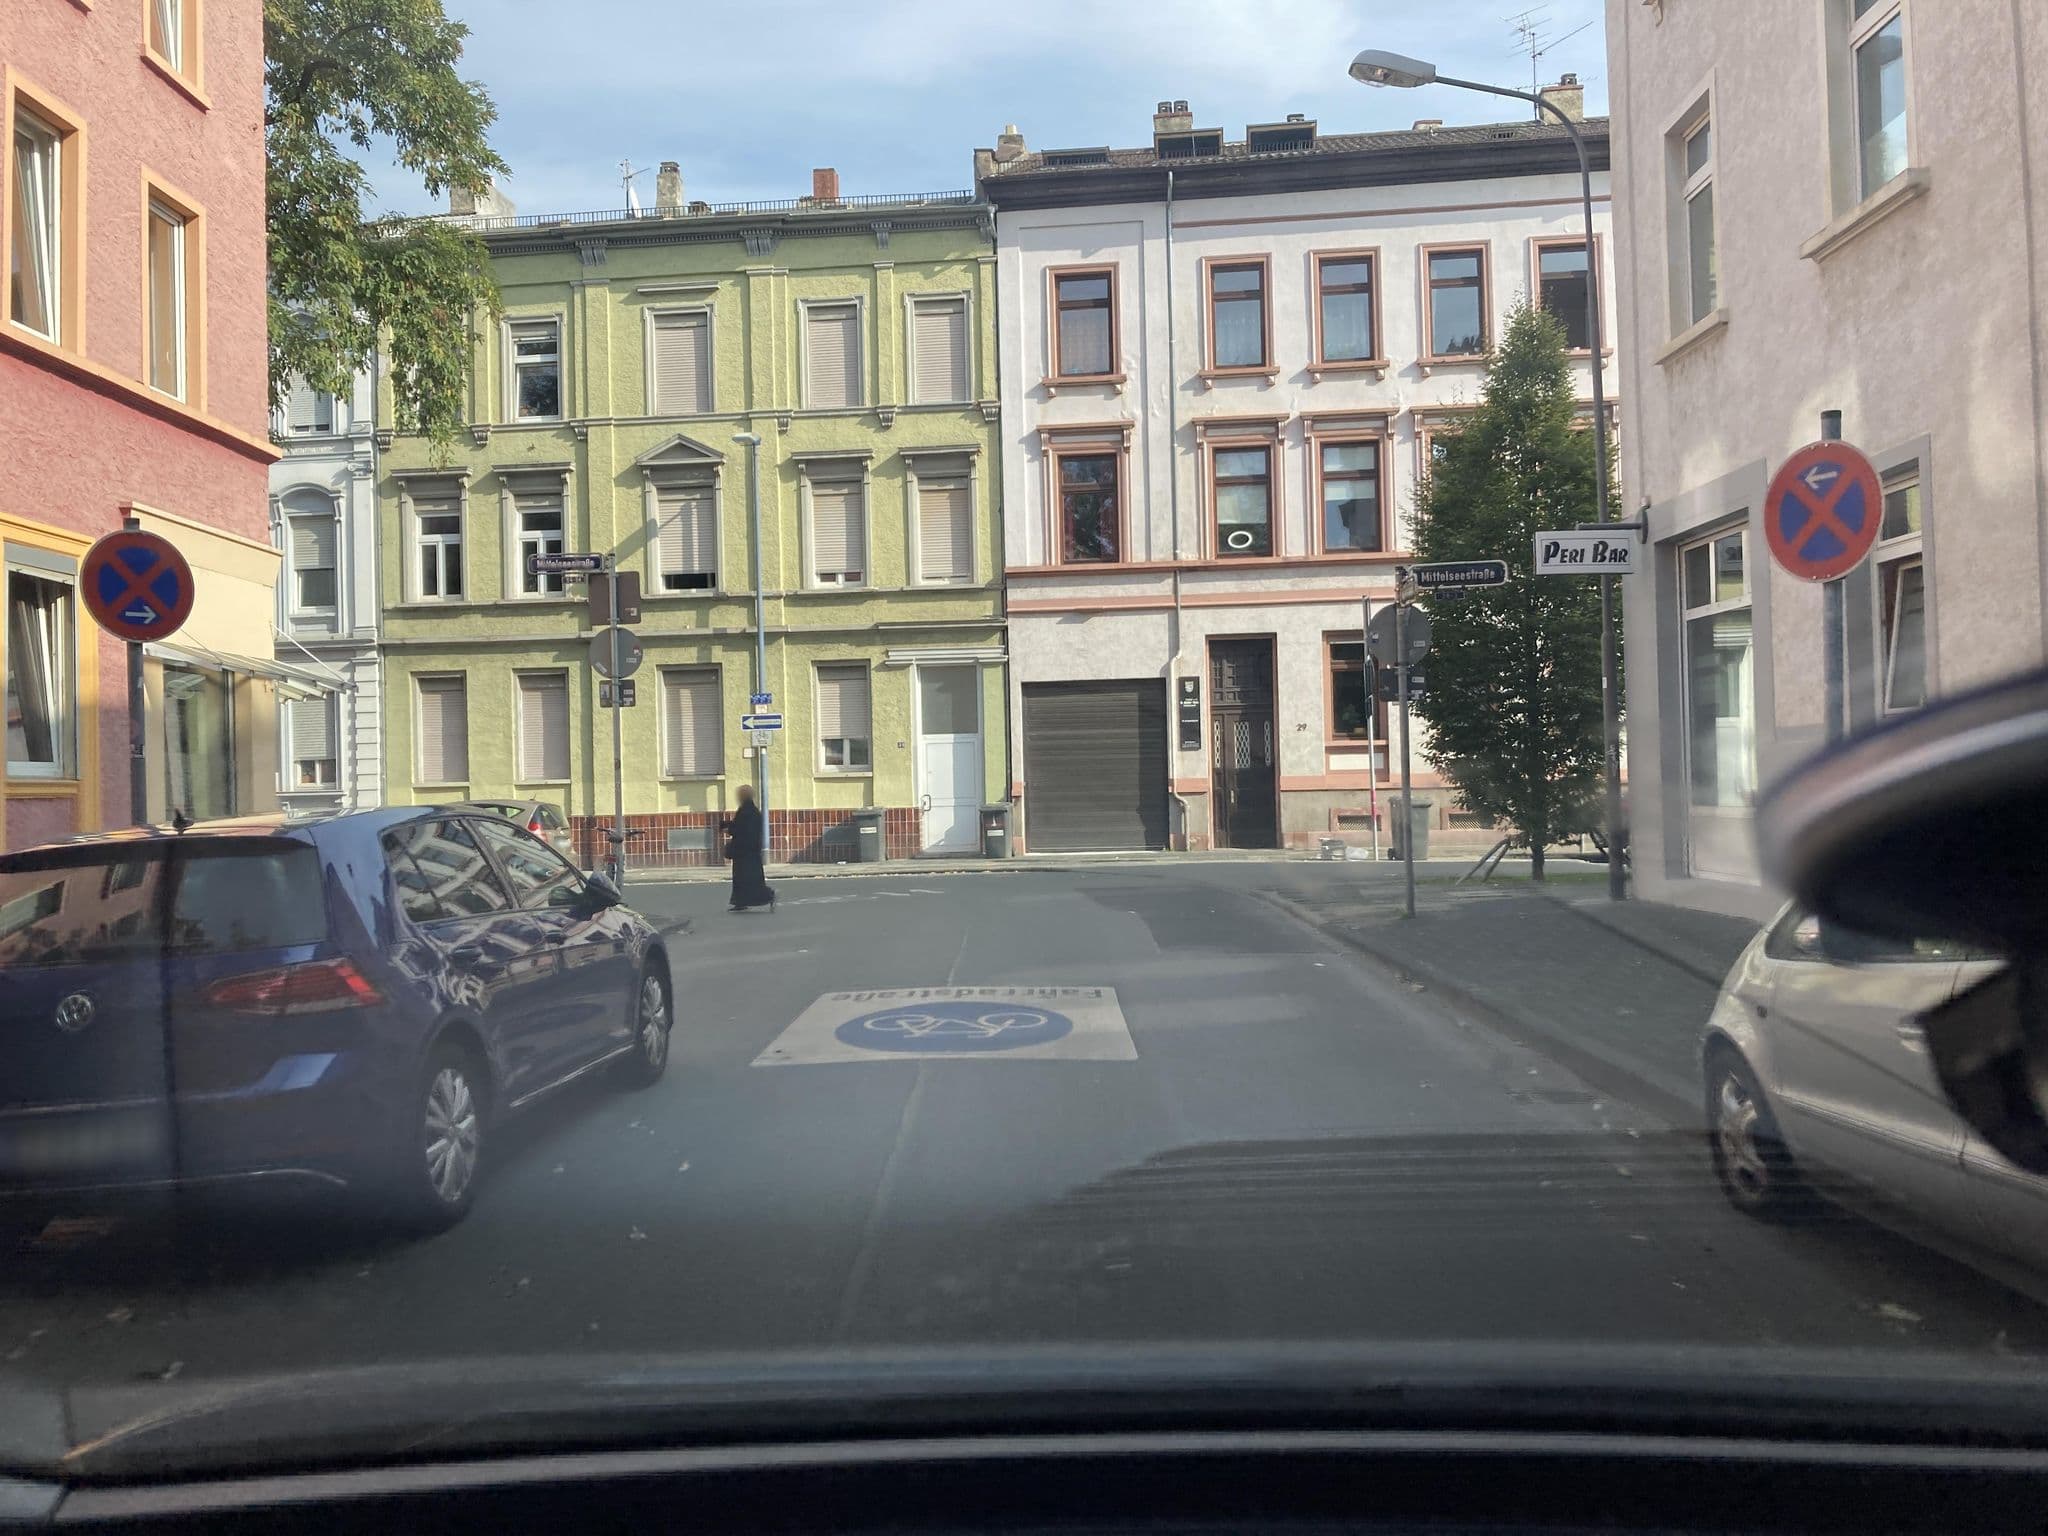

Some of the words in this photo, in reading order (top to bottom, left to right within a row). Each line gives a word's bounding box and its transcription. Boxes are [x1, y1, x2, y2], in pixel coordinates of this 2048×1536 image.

[1543, 541, 1585, 564] PERI
[1591, 540, 1628, 563] BAR
[1421, 568, 1495, 583] Mittelseestraße
